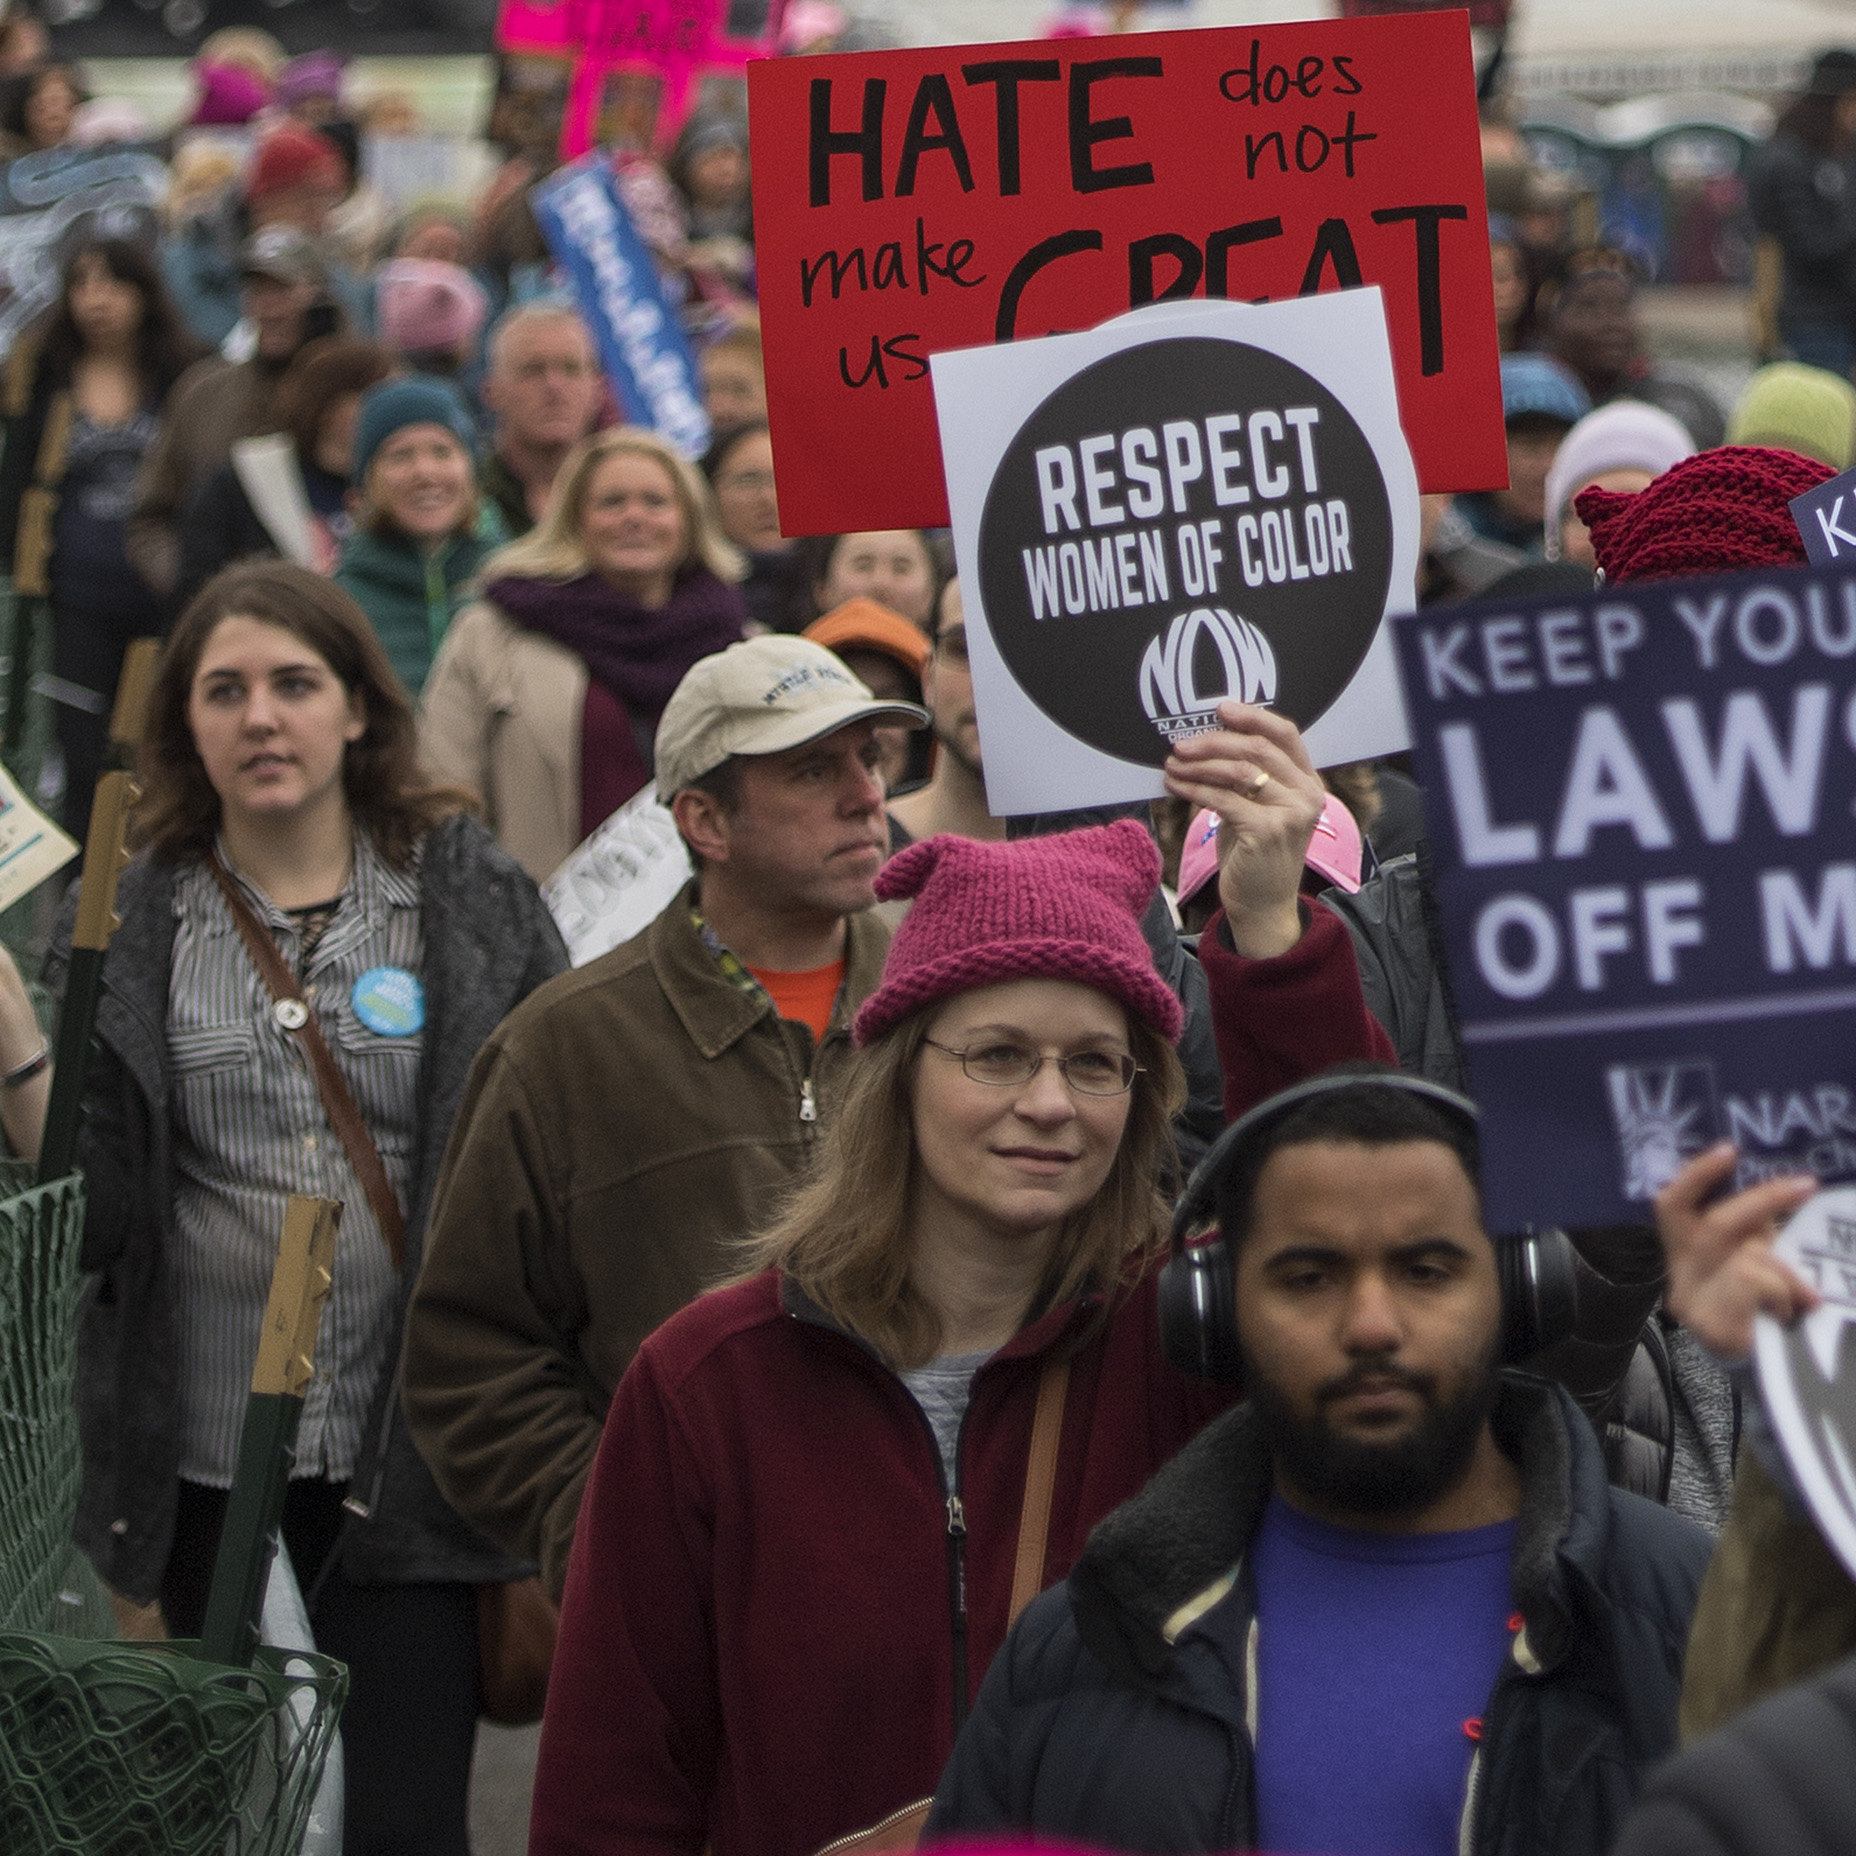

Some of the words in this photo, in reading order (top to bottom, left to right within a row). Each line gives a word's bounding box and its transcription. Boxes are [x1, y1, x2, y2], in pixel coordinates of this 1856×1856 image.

[1218, 39, 1362, 105] does
[809, 57, 1163, 207] HATE
[1245, 110, 1377, 179] not
[801, 217, 986, 307] make
[839, 333, 930, 388] us
[1034, 407, 1320, 534] RESPECT
[1022, 529, 1170, 621] WOMEN
[1177, 519, 1223, 597] OF
[1237, 499, 1353, 587] COLOR
[1139, 608, 1277, 719] NOW
[1419, 603, 1645, 700] KEEP
[1473, 878, 1705, 1001] OFF
